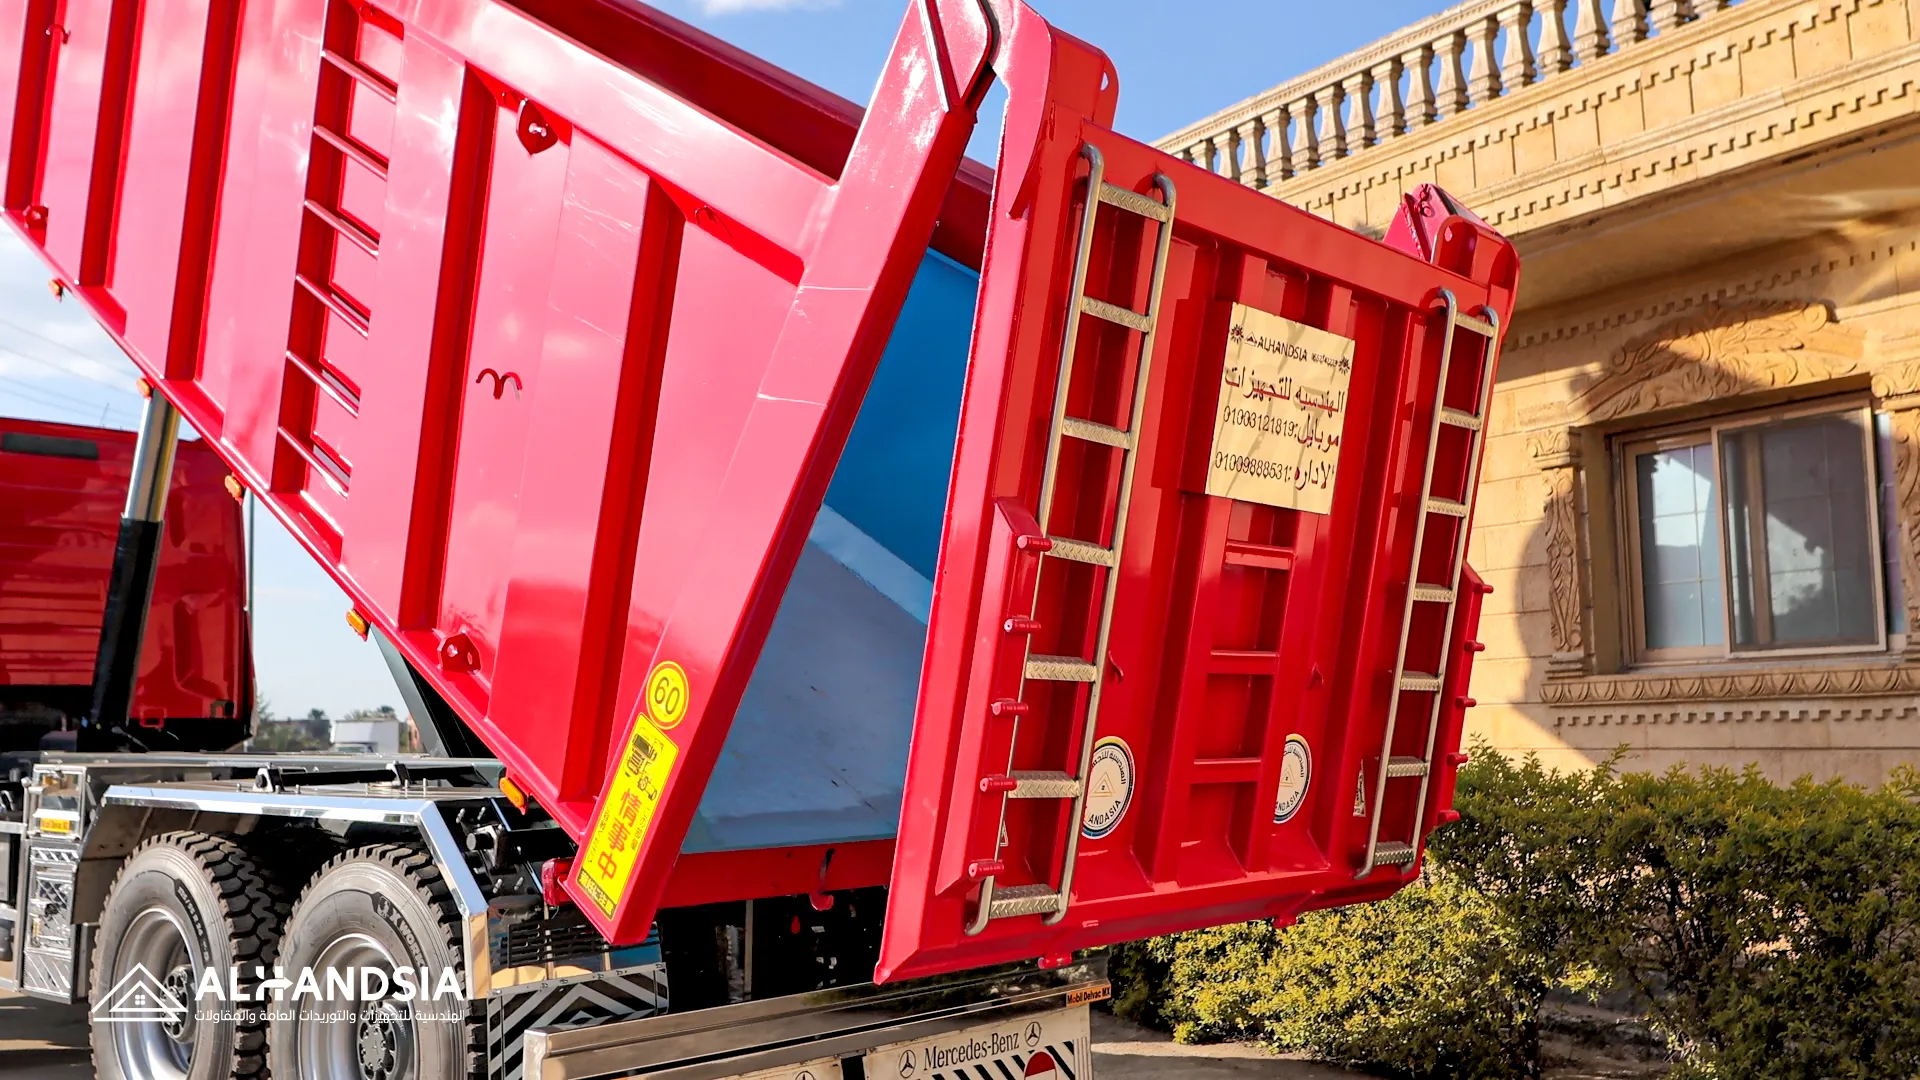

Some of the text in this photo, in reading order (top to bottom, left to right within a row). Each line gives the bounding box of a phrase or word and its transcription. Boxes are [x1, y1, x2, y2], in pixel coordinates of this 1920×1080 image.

[1257, 336, 1308, 362] ALHANDSIA
[654, 676, 680, 715] 60
[923, 1031, 1019, 1071] Mercedes-Benz
